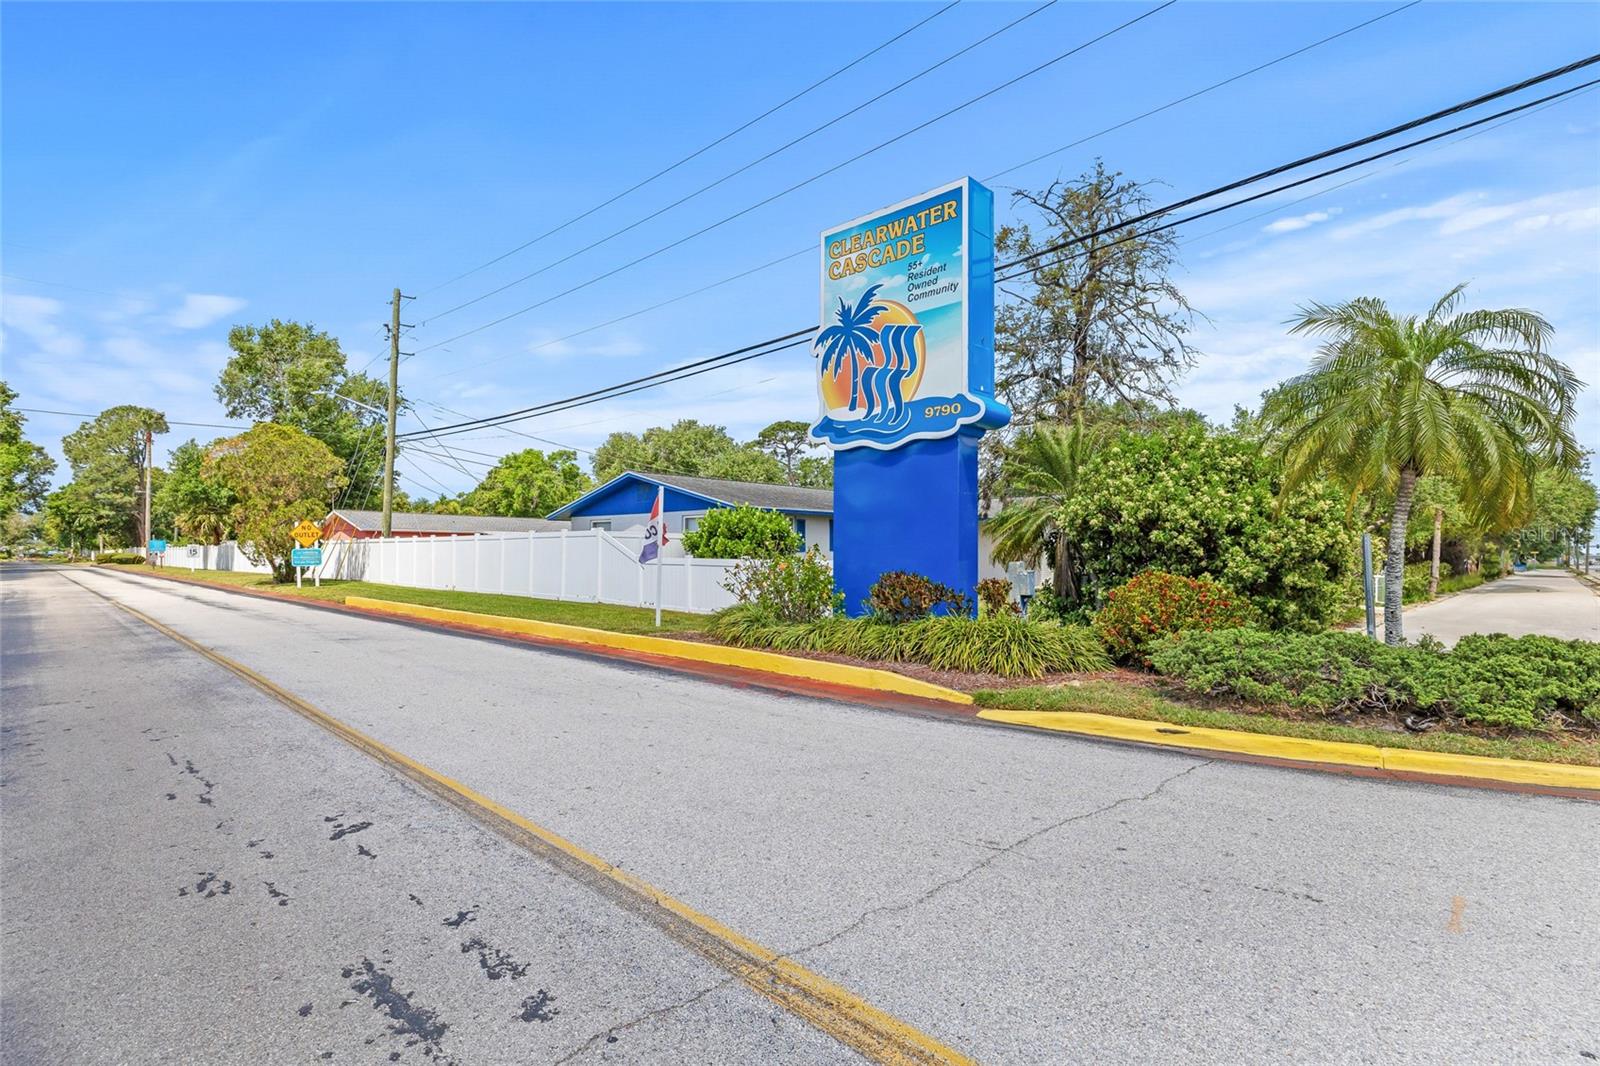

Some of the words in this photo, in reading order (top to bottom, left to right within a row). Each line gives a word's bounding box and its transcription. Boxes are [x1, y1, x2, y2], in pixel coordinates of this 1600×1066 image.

[829, 200, 958, 260] CLEARWATER
[828, 233, 925, 280] CASCADE
[907, 260, 923, 271] 55+
[907, 263, 947, 281] Resident
[907, 275, 939, 292] Owned
[907, 282, 959, 303] Community
[924, 402, 962, 418] 9790
